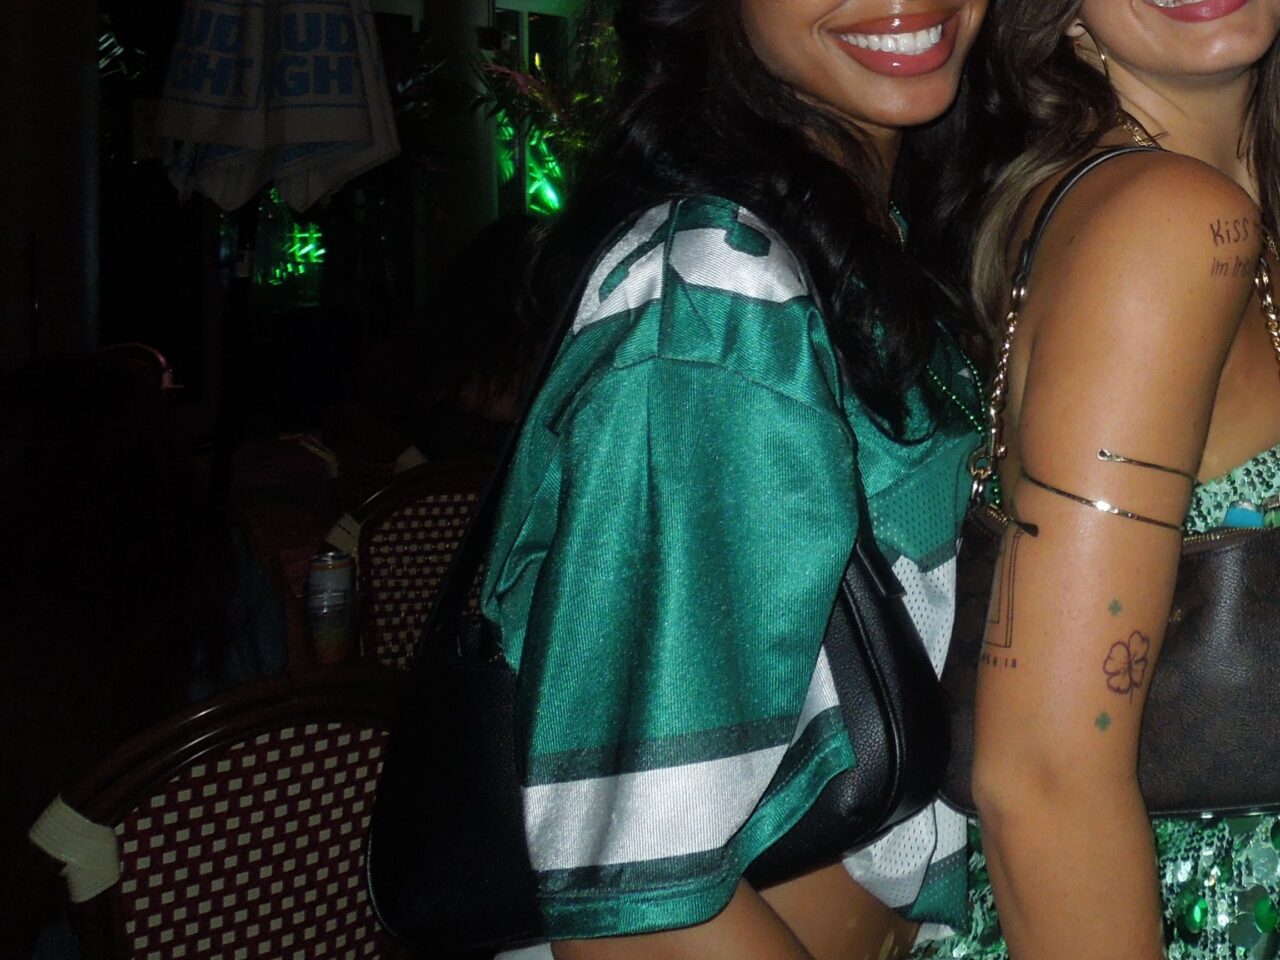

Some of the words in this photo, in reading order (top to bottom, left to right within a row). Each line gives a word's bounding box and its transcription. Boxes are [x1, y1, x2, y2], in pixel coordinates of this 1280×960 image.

[180, 9, 245, 53] UD
[278, 12, 358, 53] UD
[272, 55, 357, 98] GH
